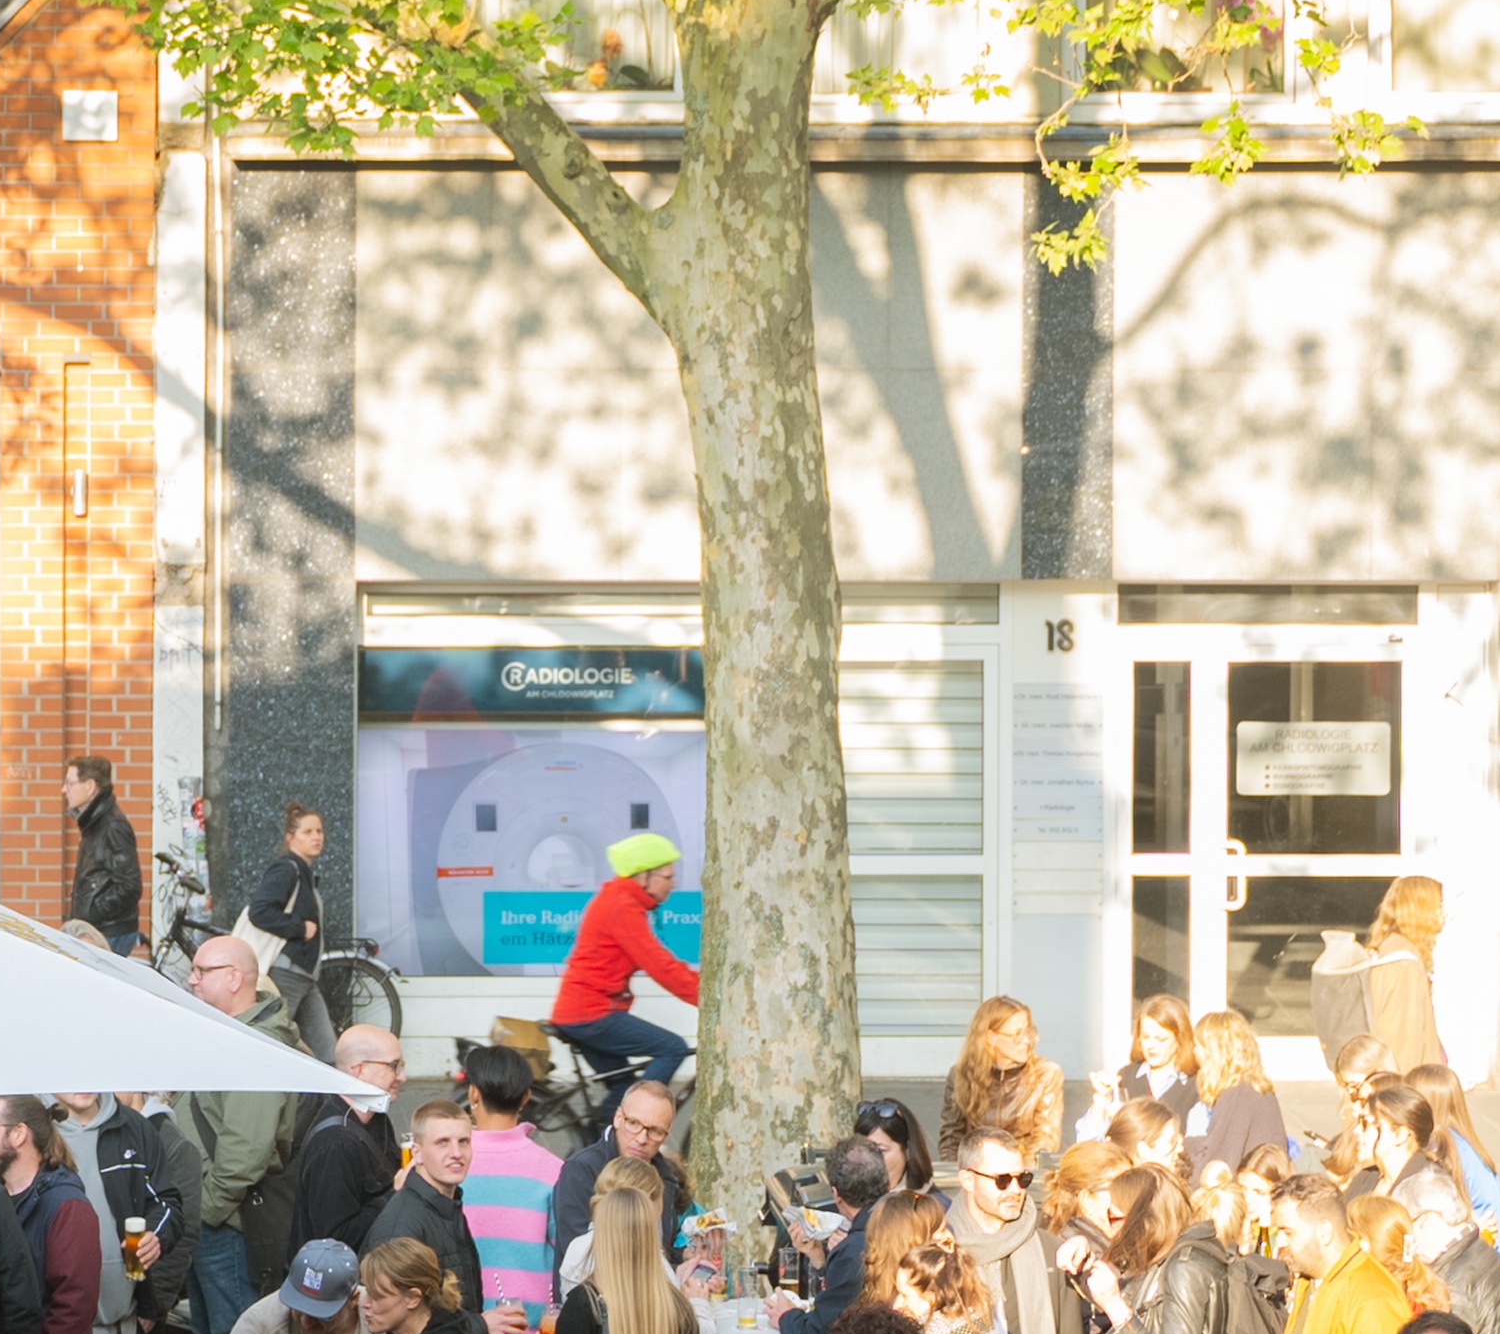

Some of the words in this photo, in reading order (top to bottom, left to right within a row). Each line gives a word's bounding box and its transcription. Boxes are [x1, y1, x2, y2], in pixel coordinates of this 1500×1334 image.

[1045, 619, 1075, 652] 18
[1275, 729, 1352, 740] RADIOLOGIE
[501, 910, 537, 925] Ihre
